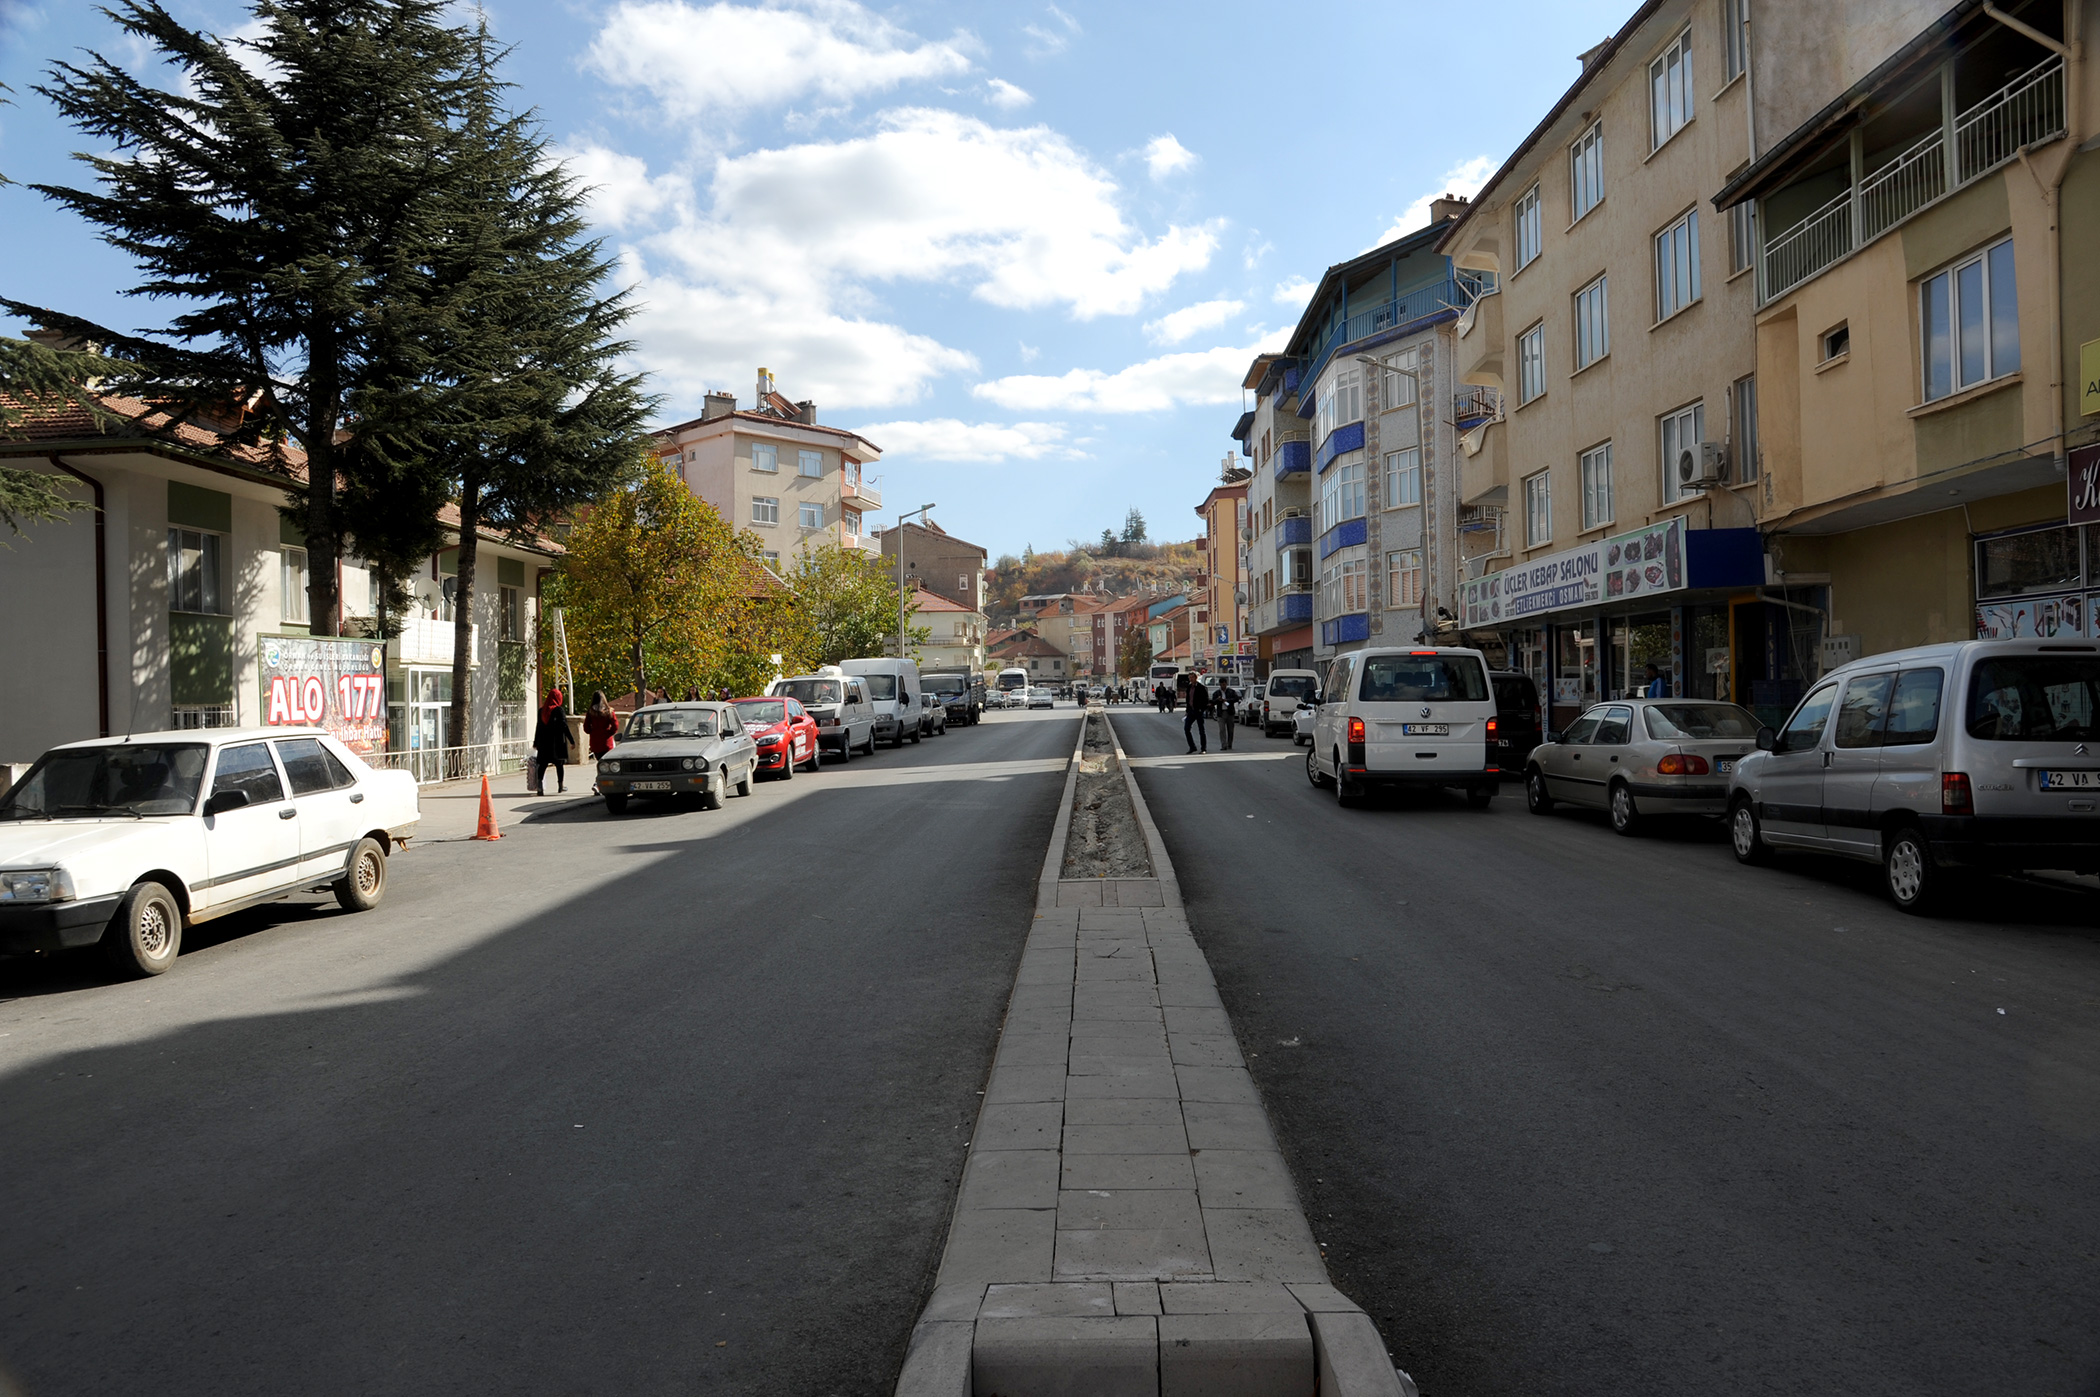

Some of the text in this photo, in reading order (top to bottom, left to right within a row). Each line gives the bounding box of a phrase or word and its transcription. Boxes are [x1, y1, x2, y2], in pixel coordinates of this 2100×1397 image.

[1504, 552, 1598, 597] ÜÇLER KEBAP SALONU
[1559, 584, 1583, 604] OSMAN
[268, 674, 383, 725] ALO 177
[363, 724, 383, 741] Hattı
[1407, 725, 1447, 733] 42 VF 295
[1722, 761, 1732, 771] 35
[2048, 773, 2064, 786] 42
